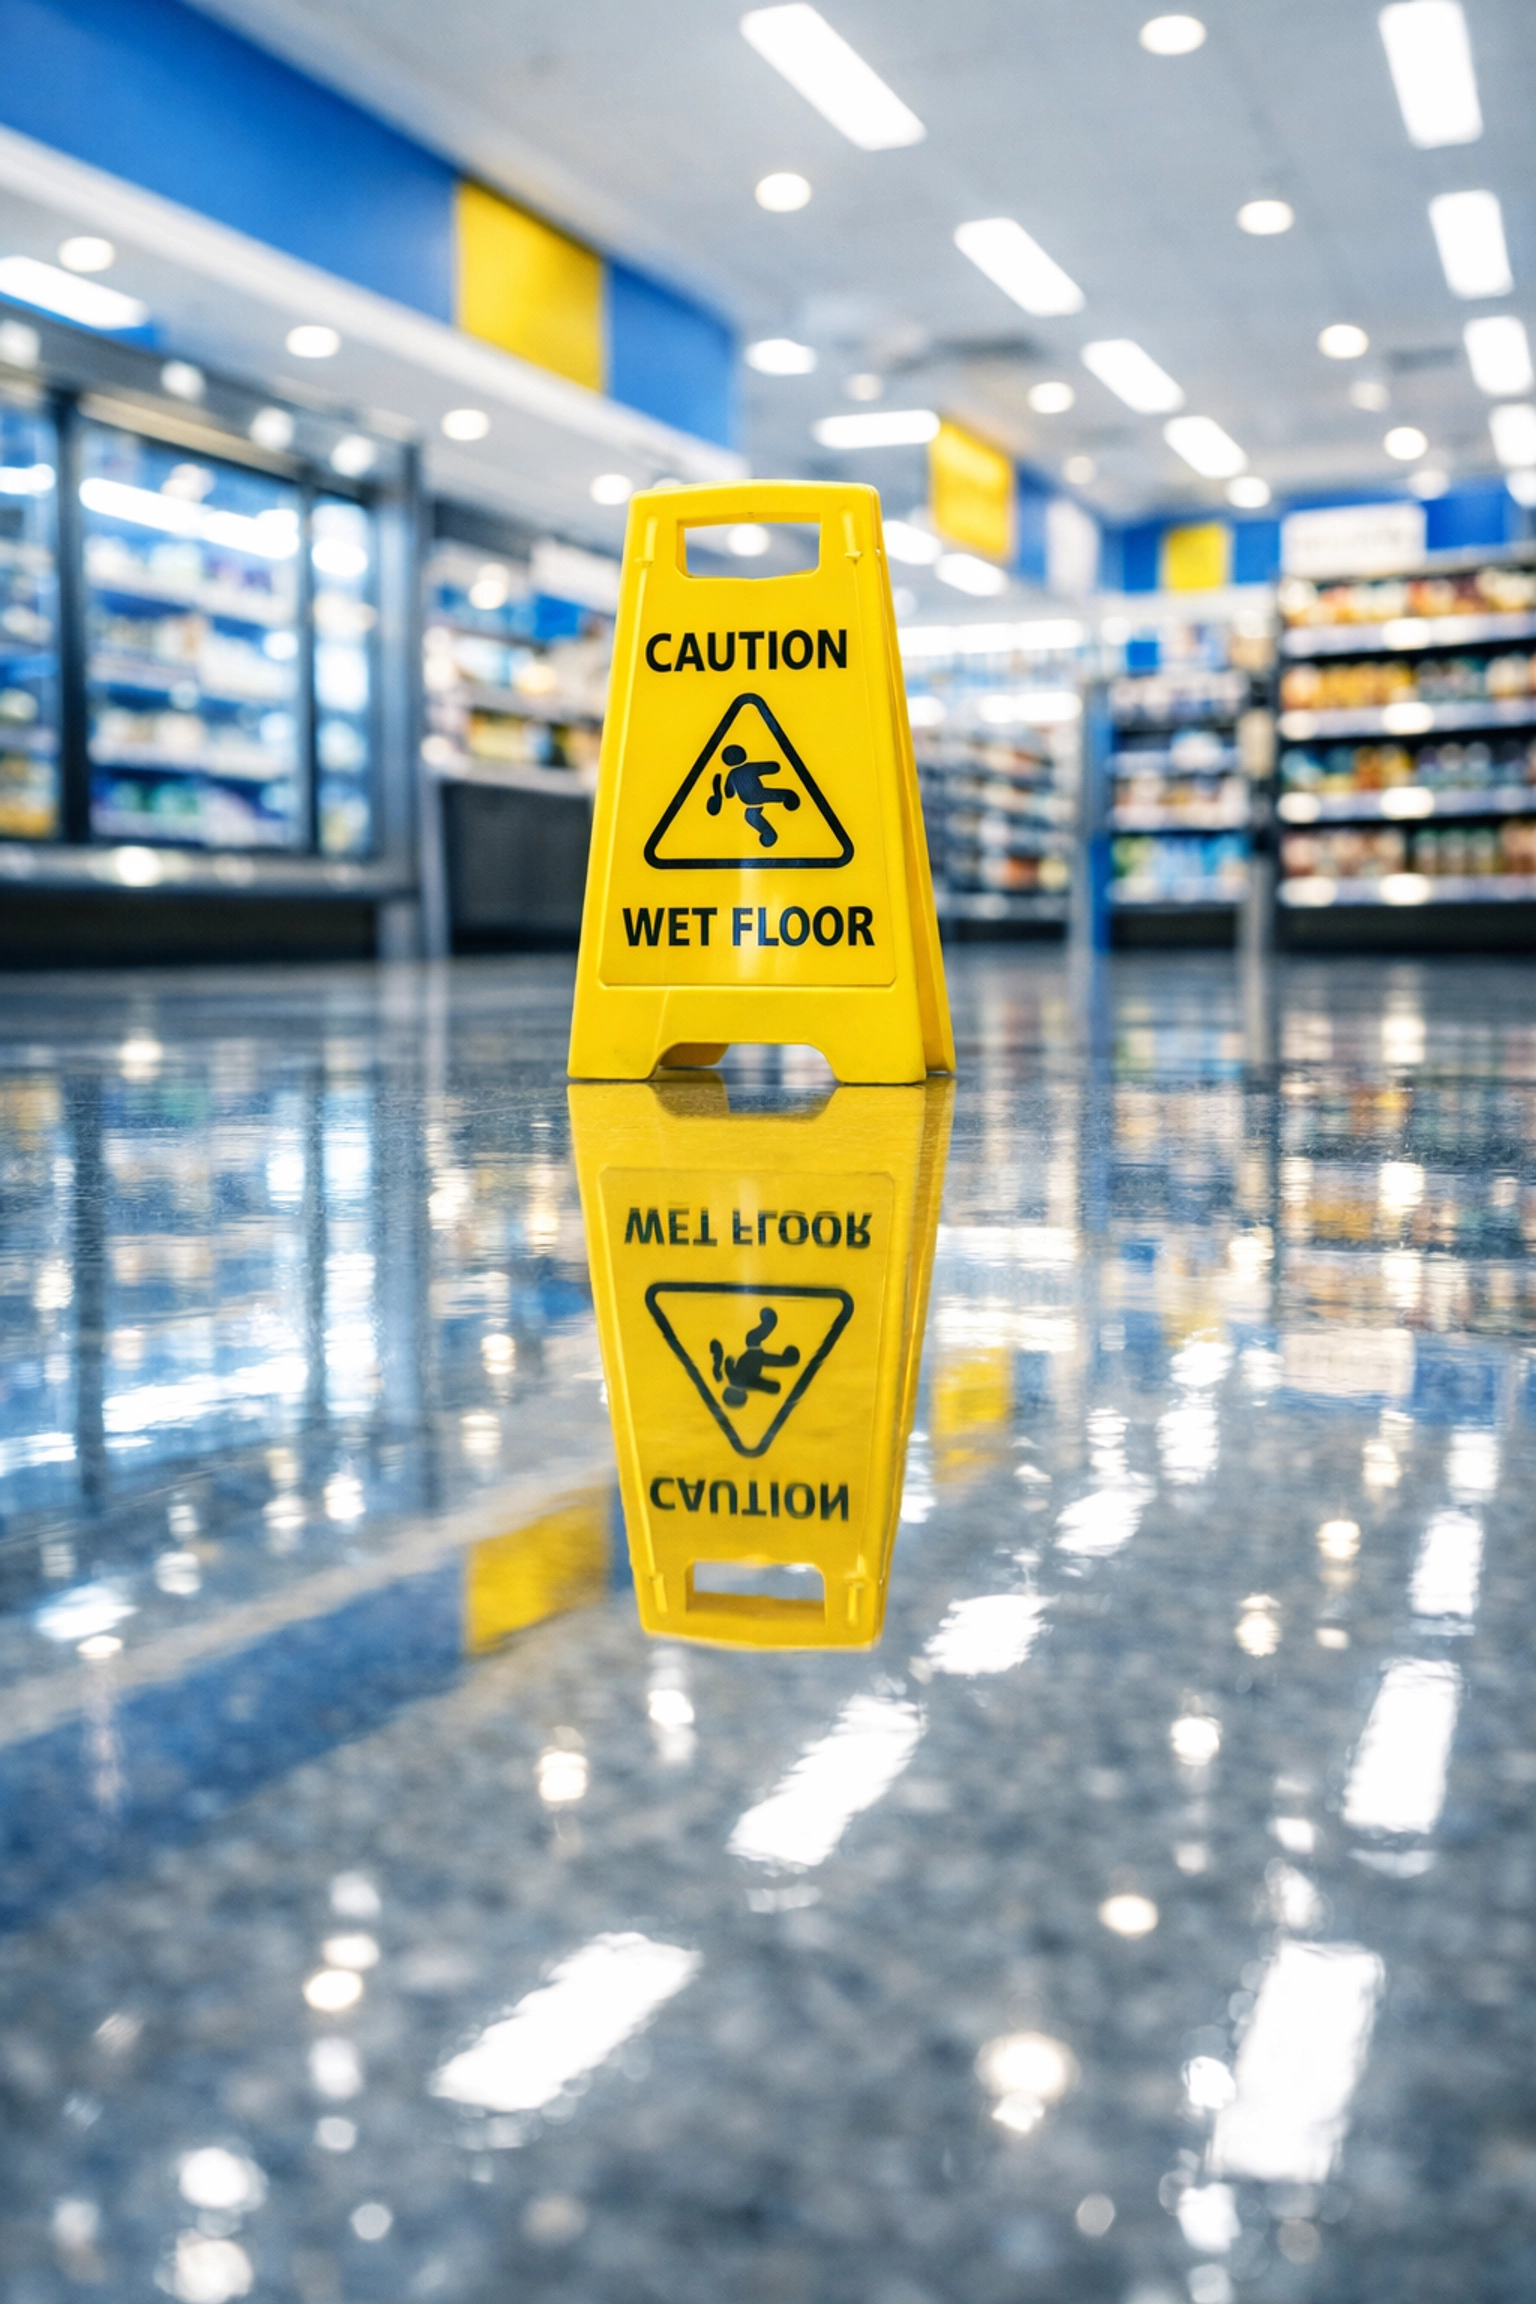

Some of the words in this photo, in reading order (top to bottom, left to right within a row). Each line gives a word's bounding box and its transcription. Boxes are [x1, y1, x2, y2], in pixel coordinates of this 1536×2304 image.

[645, 629, 848, 672] CAUTION
[622, 907, 718, 947] WET
[732, 906, 875, 947] FLOOR
